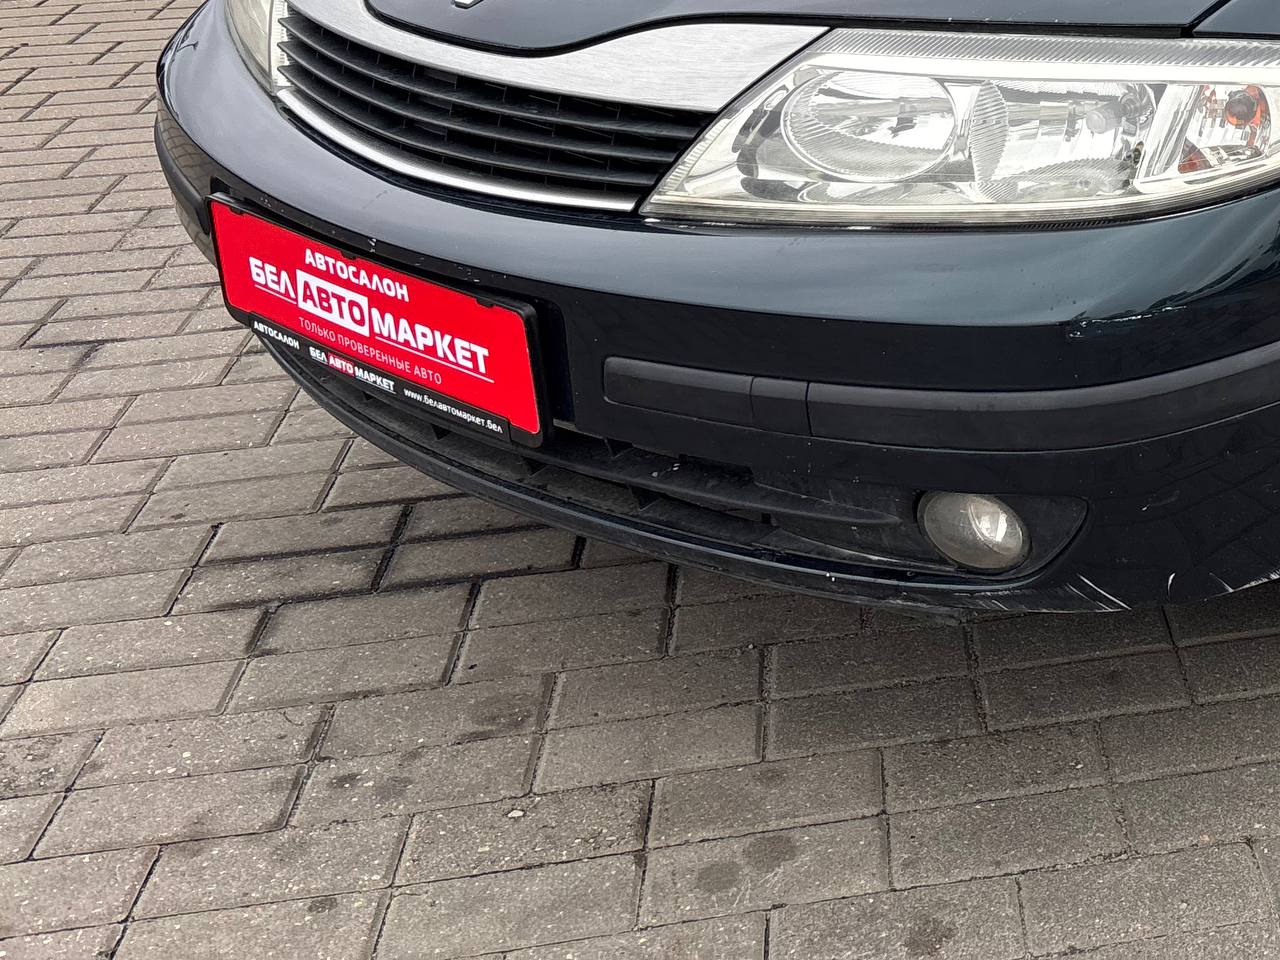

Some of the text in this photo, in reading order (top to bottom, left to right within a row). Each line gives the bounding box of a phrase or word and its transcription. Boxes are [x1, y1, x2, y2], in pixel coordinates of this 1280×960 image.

[305, 248, 410, 302] АВТОСАЛОН
[249, 256, 490, 374] БЕЛ АВТО МАРКЕТ
[253, 320, 300, 350] АВТОСАЛОН
[298, 317, 442, 385] ТОЛЬКО ПРОВЕРЕННЫЕ АВТО
[308, 346, 395, 391] БЕЛ АВТО МАРКЕТ
[403, 388, 503, 434] www.белавтомаркет.бел
